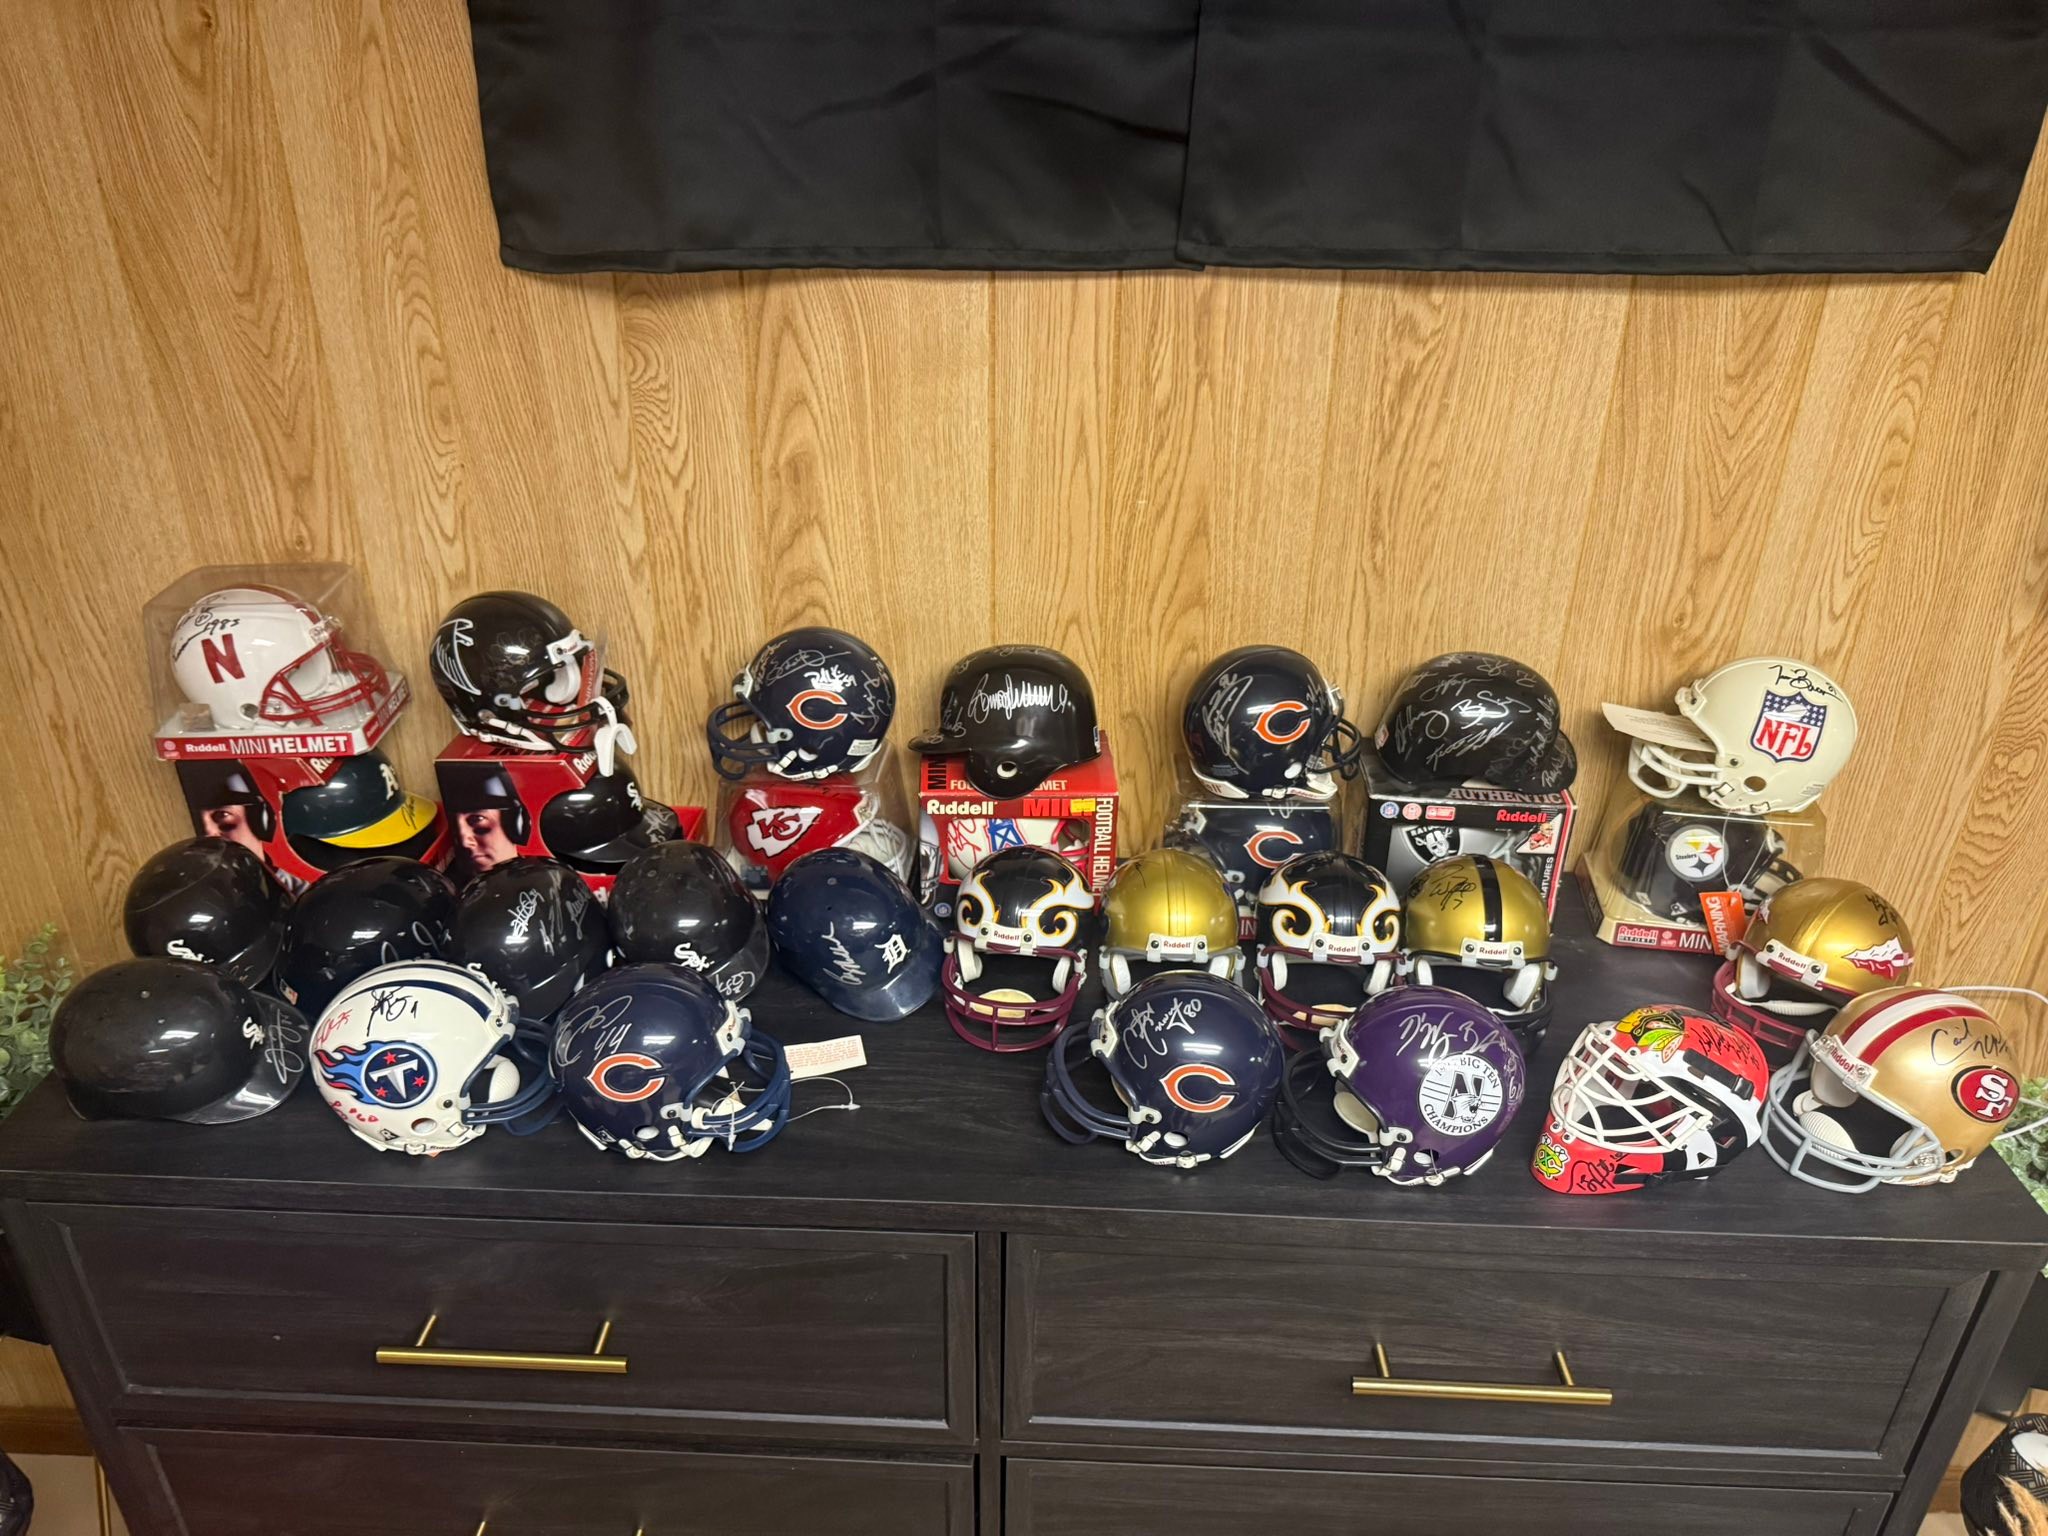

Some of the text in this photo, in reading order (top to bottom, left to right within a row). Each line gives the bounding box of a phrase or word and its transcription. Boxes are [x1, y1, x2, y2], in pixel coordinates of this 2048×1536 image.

[201, 634, 245, 683] N
[185, 736, 348, 755] Riddell MINI HELMET
[1756, 717, 1811, 758] NFL
[1446, 788, 1563, 804] AUTHENTIC
[926, 799, 994, 815] Riddell
[1497, 809, 1548, 823] Riddell
[1093, 797, 1114, 855] FOOTBALL
[994, 930, 1020, 942] Riddell
[1163, 940, 1192, 950] Riddell
[1678, 932, 1712, 951] MIN
[1328, 943, 1357, 953] Riddell
[1479, 946, 1508, 956] Riddell
[1777, 951, 1806, 970] Riddell
[593, 1023, 632, 1061] 44
[1459, 1057, 1480, 1069] BIG
[1482, 1065, 1499, 1089] TEN
[1423, 1103, 1489, 1133] CHAMPIONS
